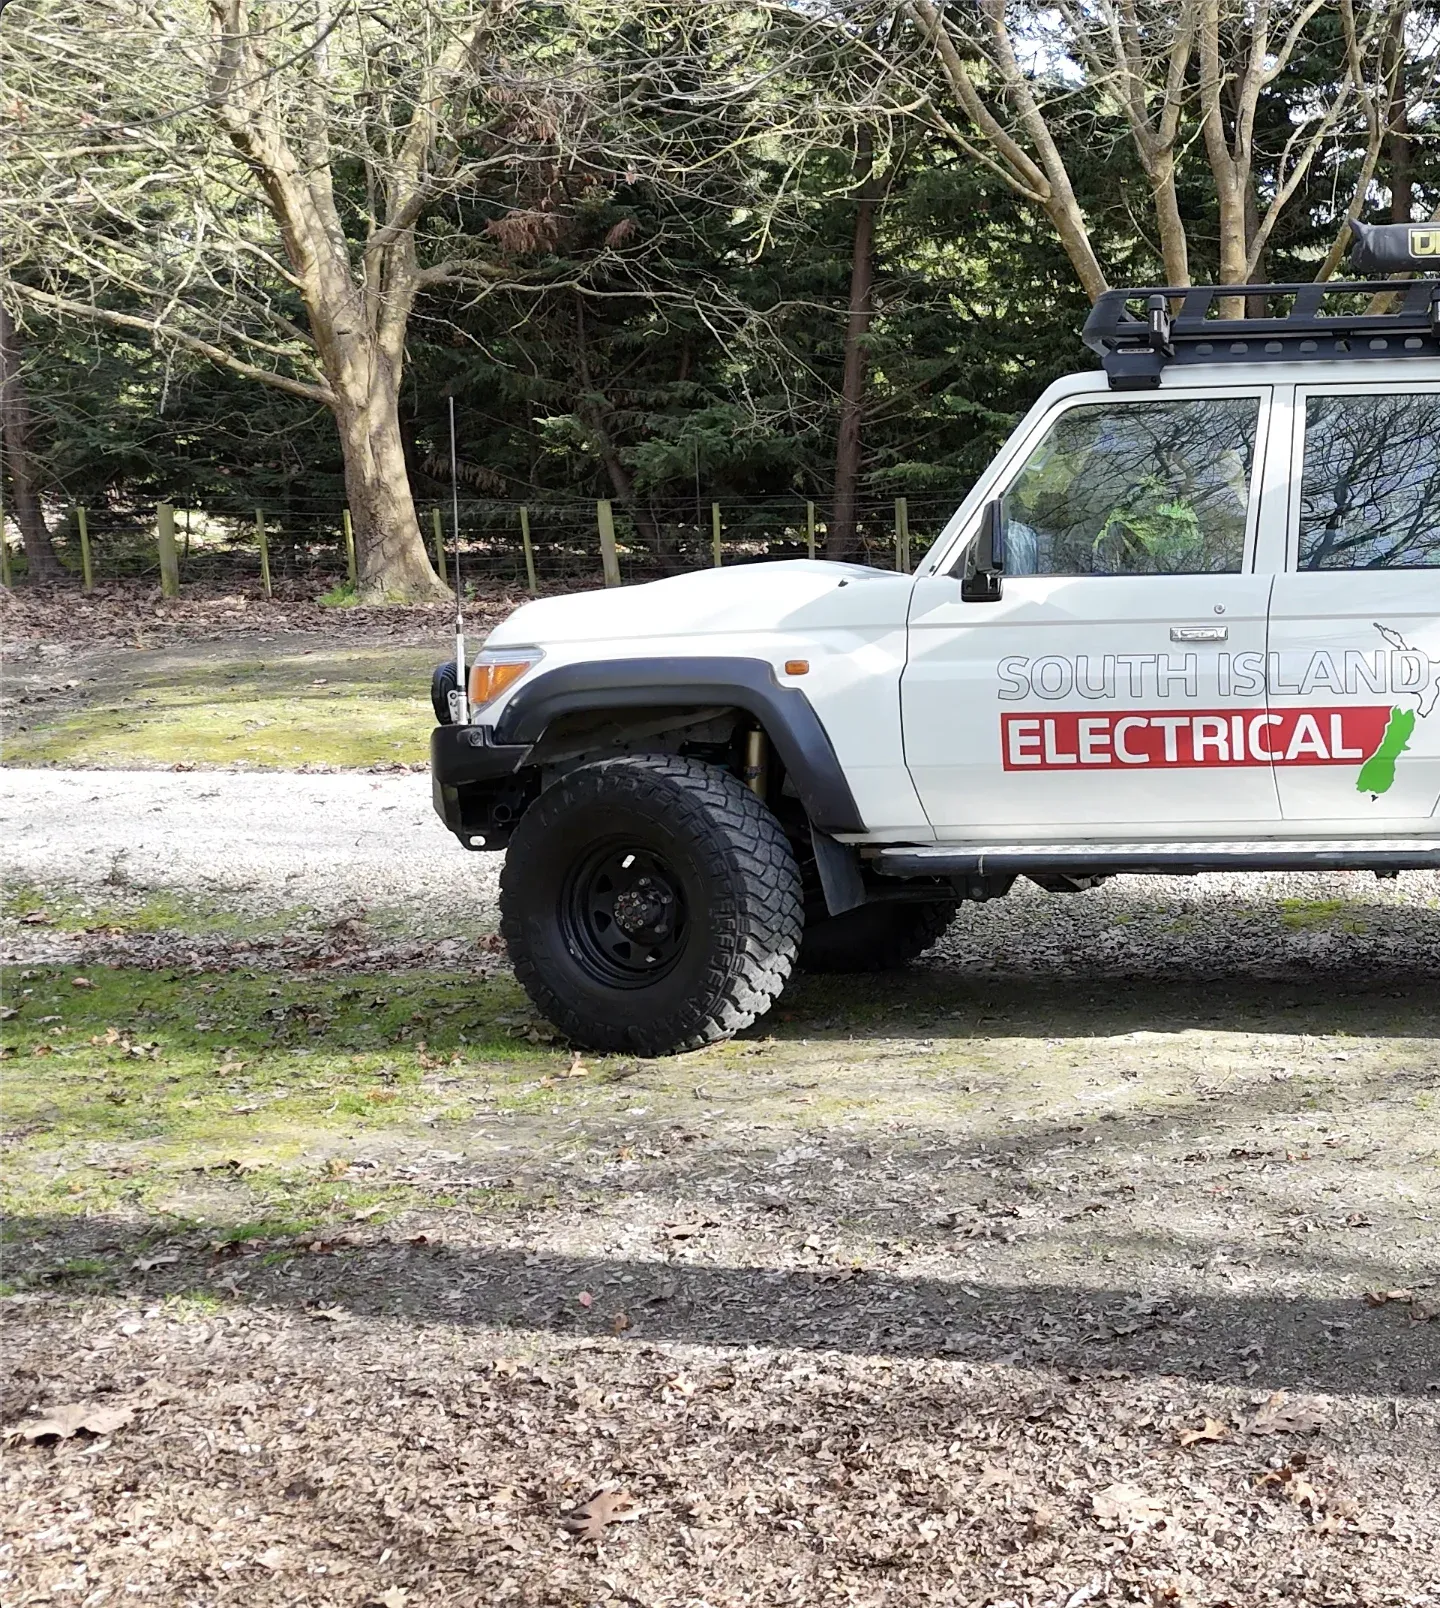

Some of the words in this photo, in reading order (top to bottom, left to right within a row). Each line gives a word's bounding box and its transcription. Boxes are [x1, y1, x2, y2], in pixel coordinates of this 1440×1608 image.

[997, 654, 1198, 700] SOUTH
[1218, 649, 1430, 697] ISLAND
[1007, 712, 1364, 765] ELECTRICAL
